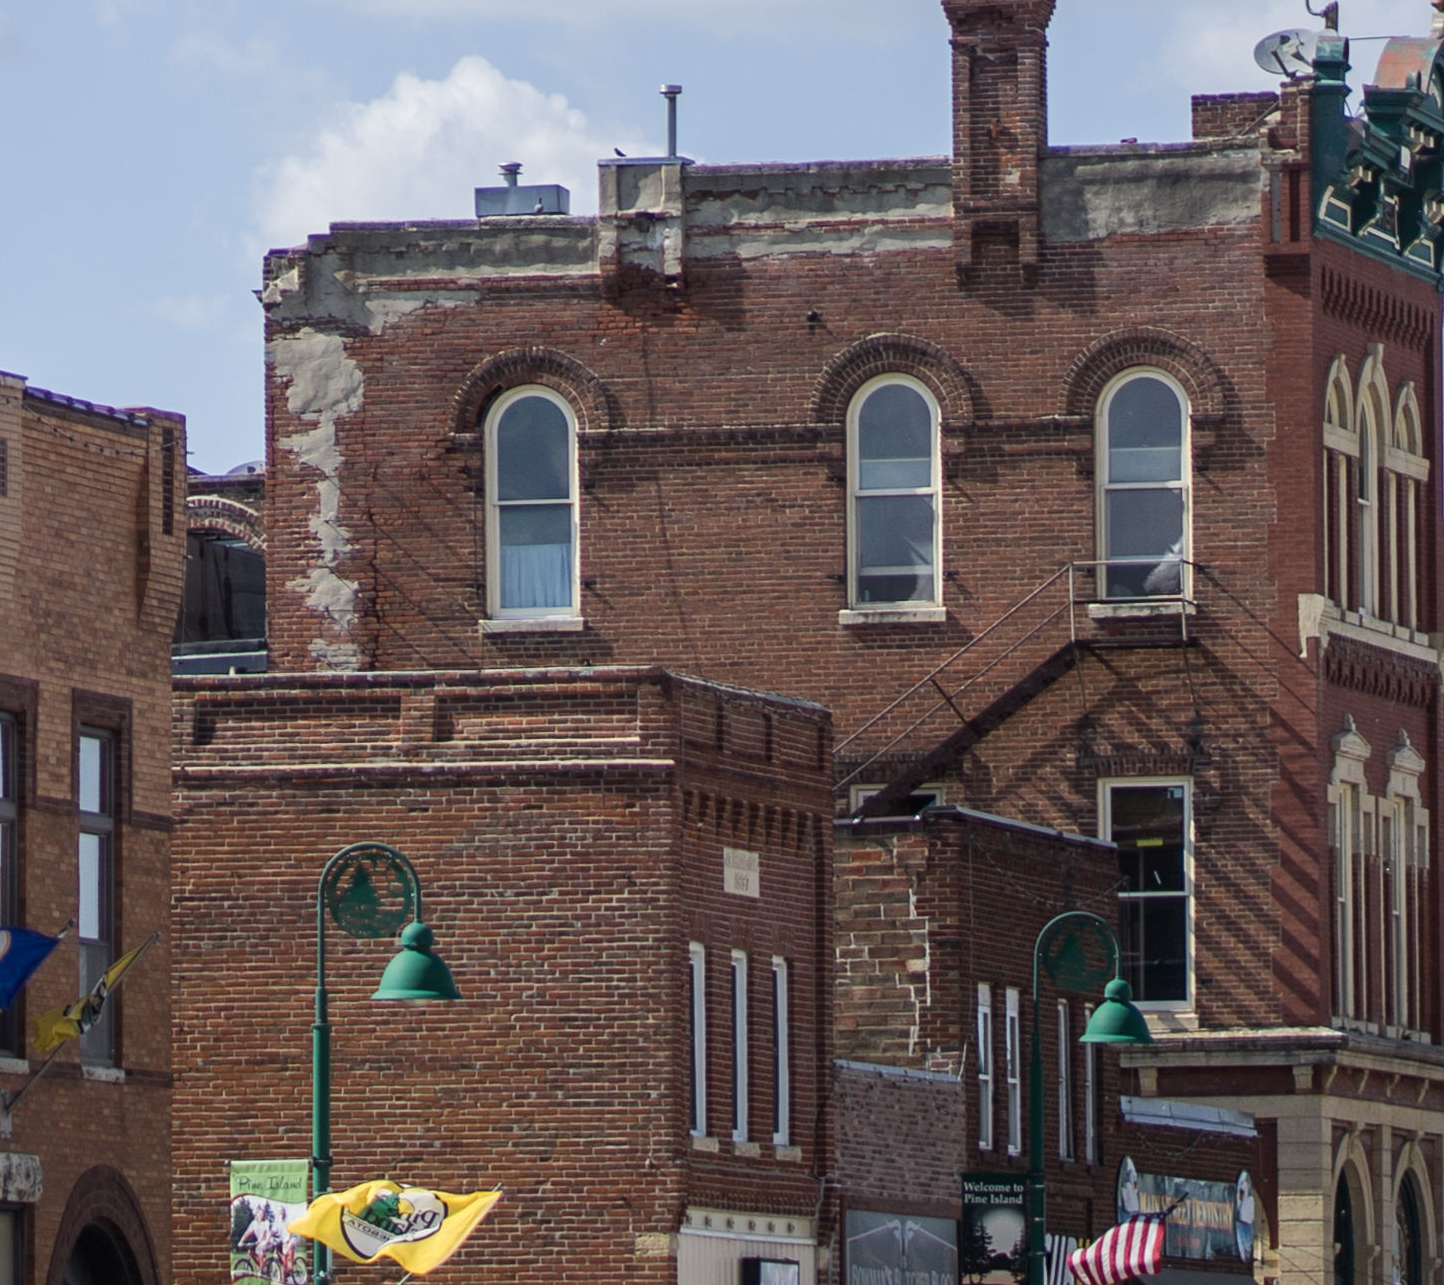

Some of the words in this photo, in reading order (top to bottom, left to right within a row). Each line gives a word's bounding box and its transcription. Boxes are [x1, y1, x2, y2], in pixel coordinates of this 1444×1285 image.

[235, 1176, 262, 1190] Pine
[265, 1176, 302, 1190] Island
[964, 1181, 1011, 1192] Welcome
[1013, 1183, 1024, 1192] to
[964, 1193, 988, 1204] Pine
[990, 1194, 1023, 1204] Island
